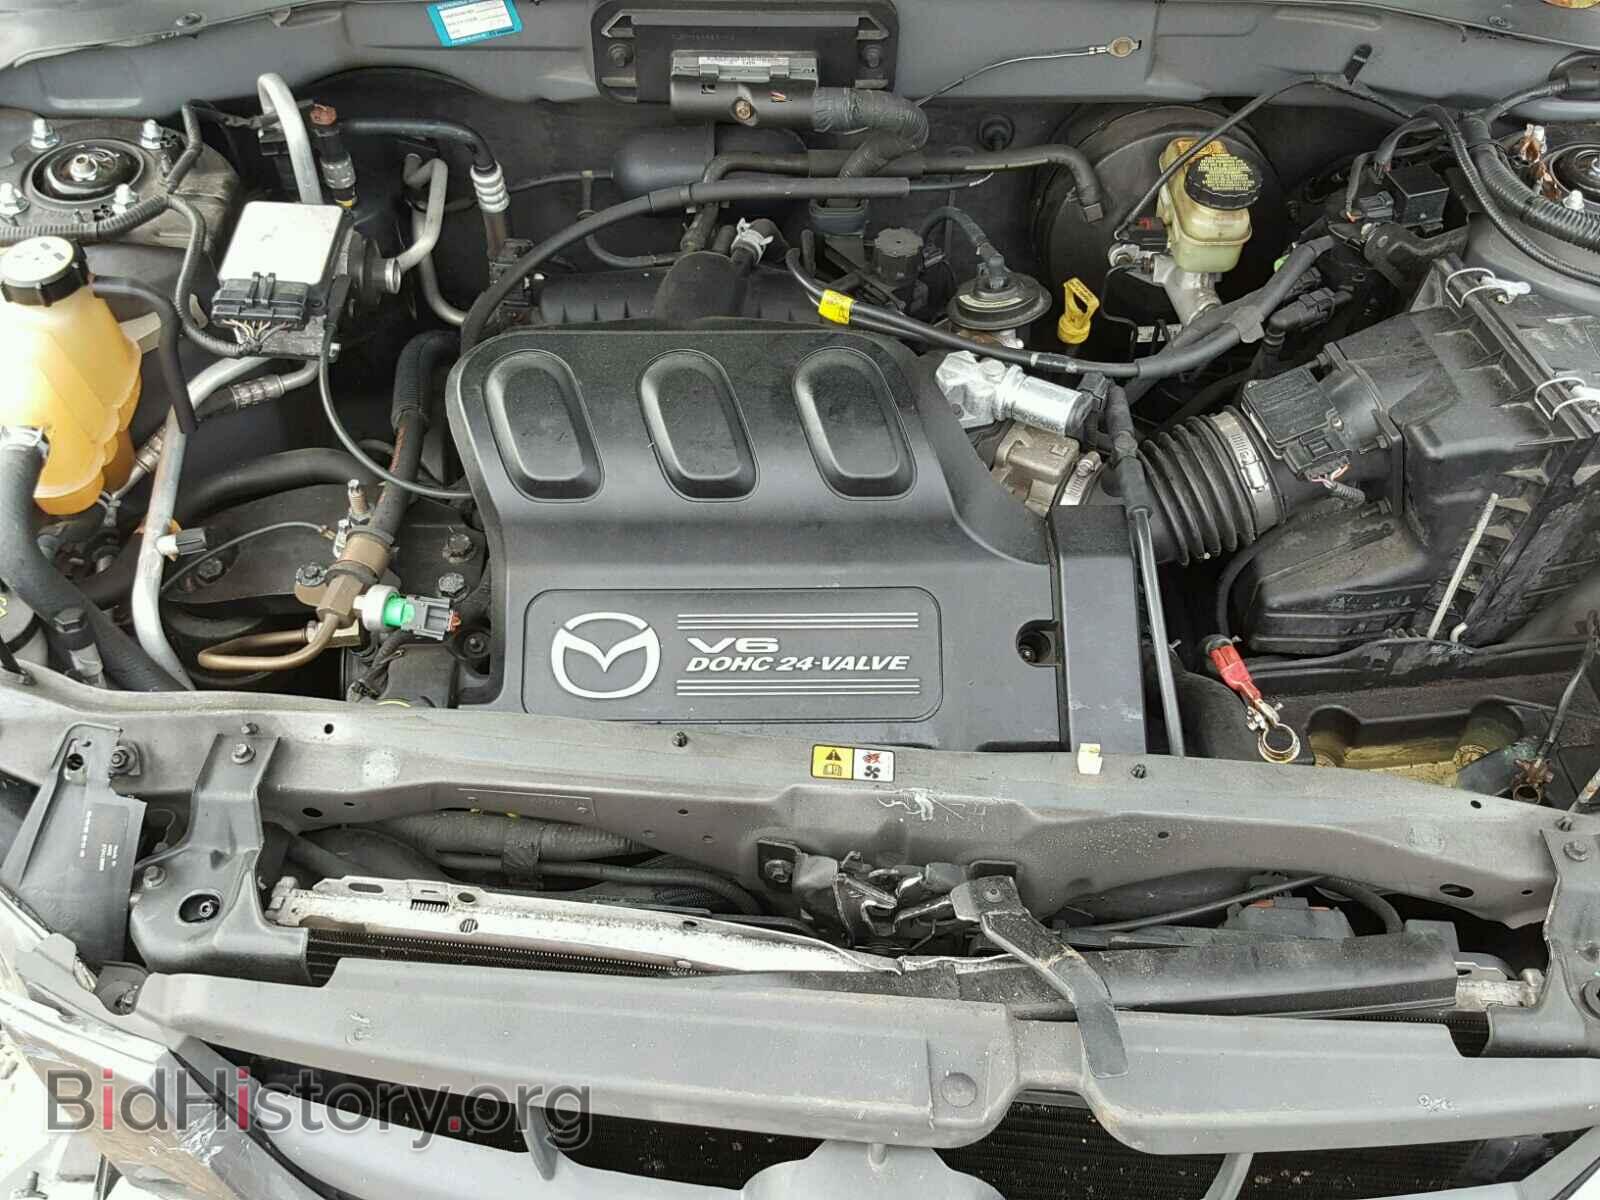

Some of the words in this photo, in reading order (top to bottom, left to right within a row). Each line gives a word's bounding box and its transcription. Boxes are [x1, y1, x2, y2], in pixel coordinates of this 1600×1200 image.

[687, 637, 779, 653] V6
[686, 656, 773, 671] DOHC
[775, 656, 909, 670] 24-VALVE
